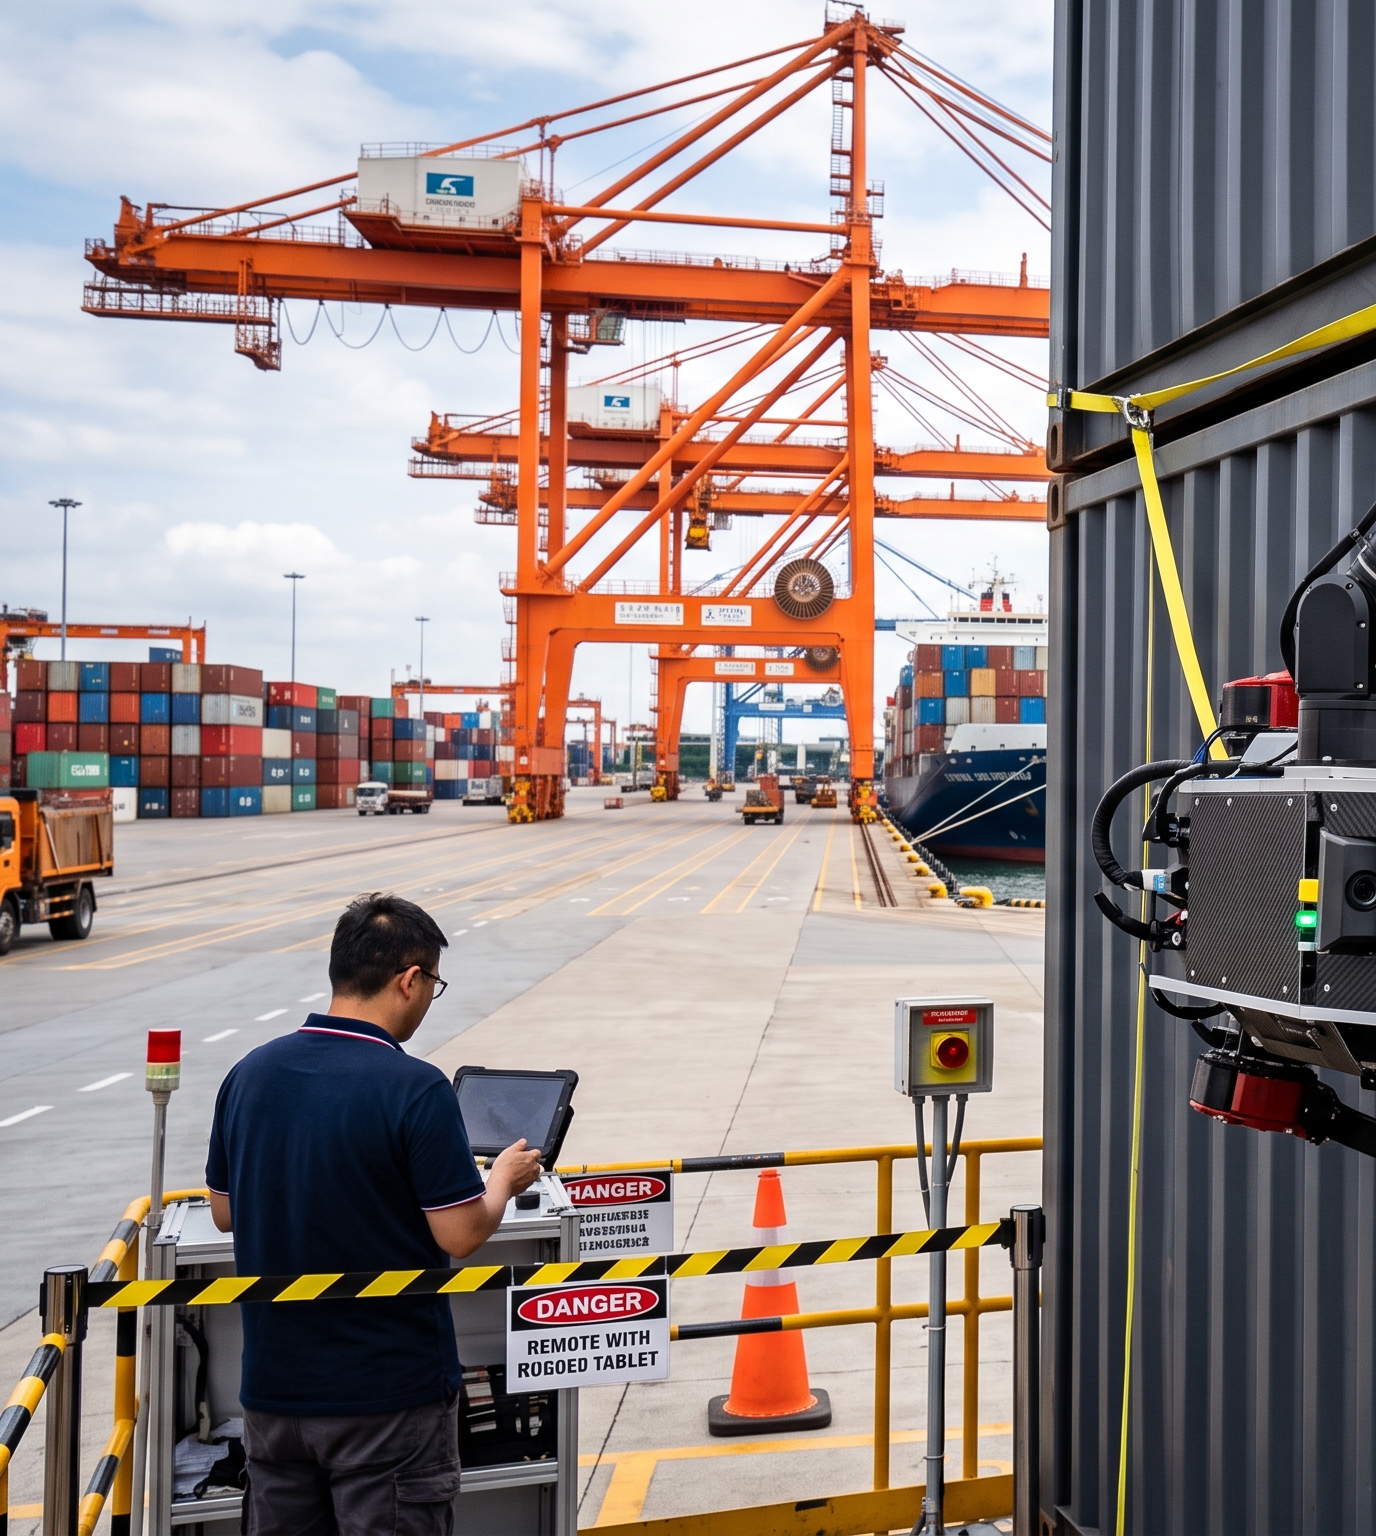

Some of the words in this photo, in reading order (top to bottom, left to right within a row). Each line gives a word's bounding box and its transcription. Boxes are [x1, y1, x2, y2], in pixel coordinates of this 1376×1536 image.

[536, 1292, 643, 1319] DANGER
[527, 1334, 600, 1356] REMOTE
[605, 1329, 651, 1348] WITH
[593, 1351, 659, 1371] TABLET
